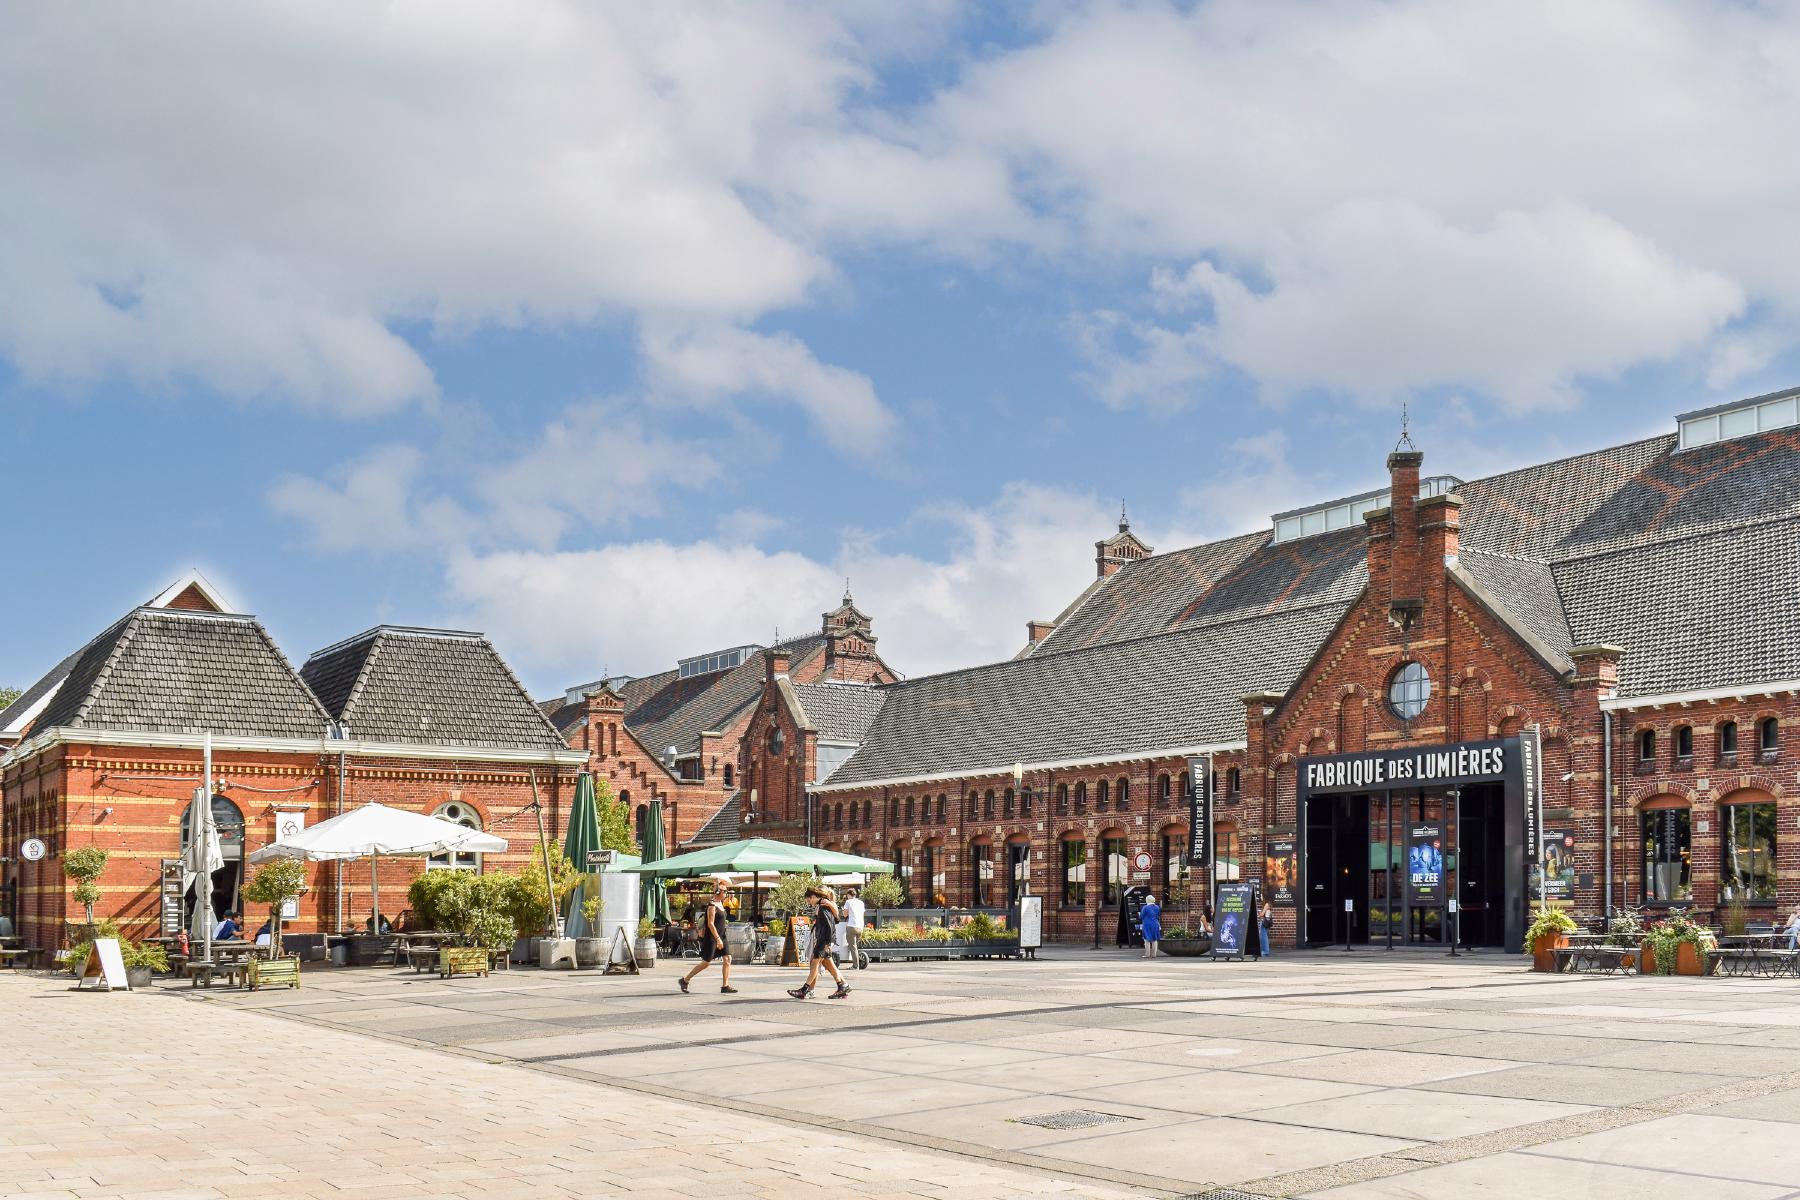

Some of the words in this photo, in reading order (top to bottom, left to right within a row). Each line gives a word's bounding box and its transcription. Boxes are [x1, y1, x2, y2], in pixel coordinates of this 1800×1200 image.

[1193, 764, 1204, 805] FABRIQUE
[1307, 758, 1384, 787] FABRIQUE
[1388, 758, 1413, 779] DES
[1416, 746, 1503, 779] LUMIÈRES
[1524, 740, 1533, 789] FABRIQUE
[1196, 805, 1204, 818] DES
[1527, 807, 1535, 855] LUMIÈRES
[1193, 819, 1205, 859] LUMIÈRES
[1412, 872, 1423, 883] DE
[1424, 872, 1439, 883] ZEE
